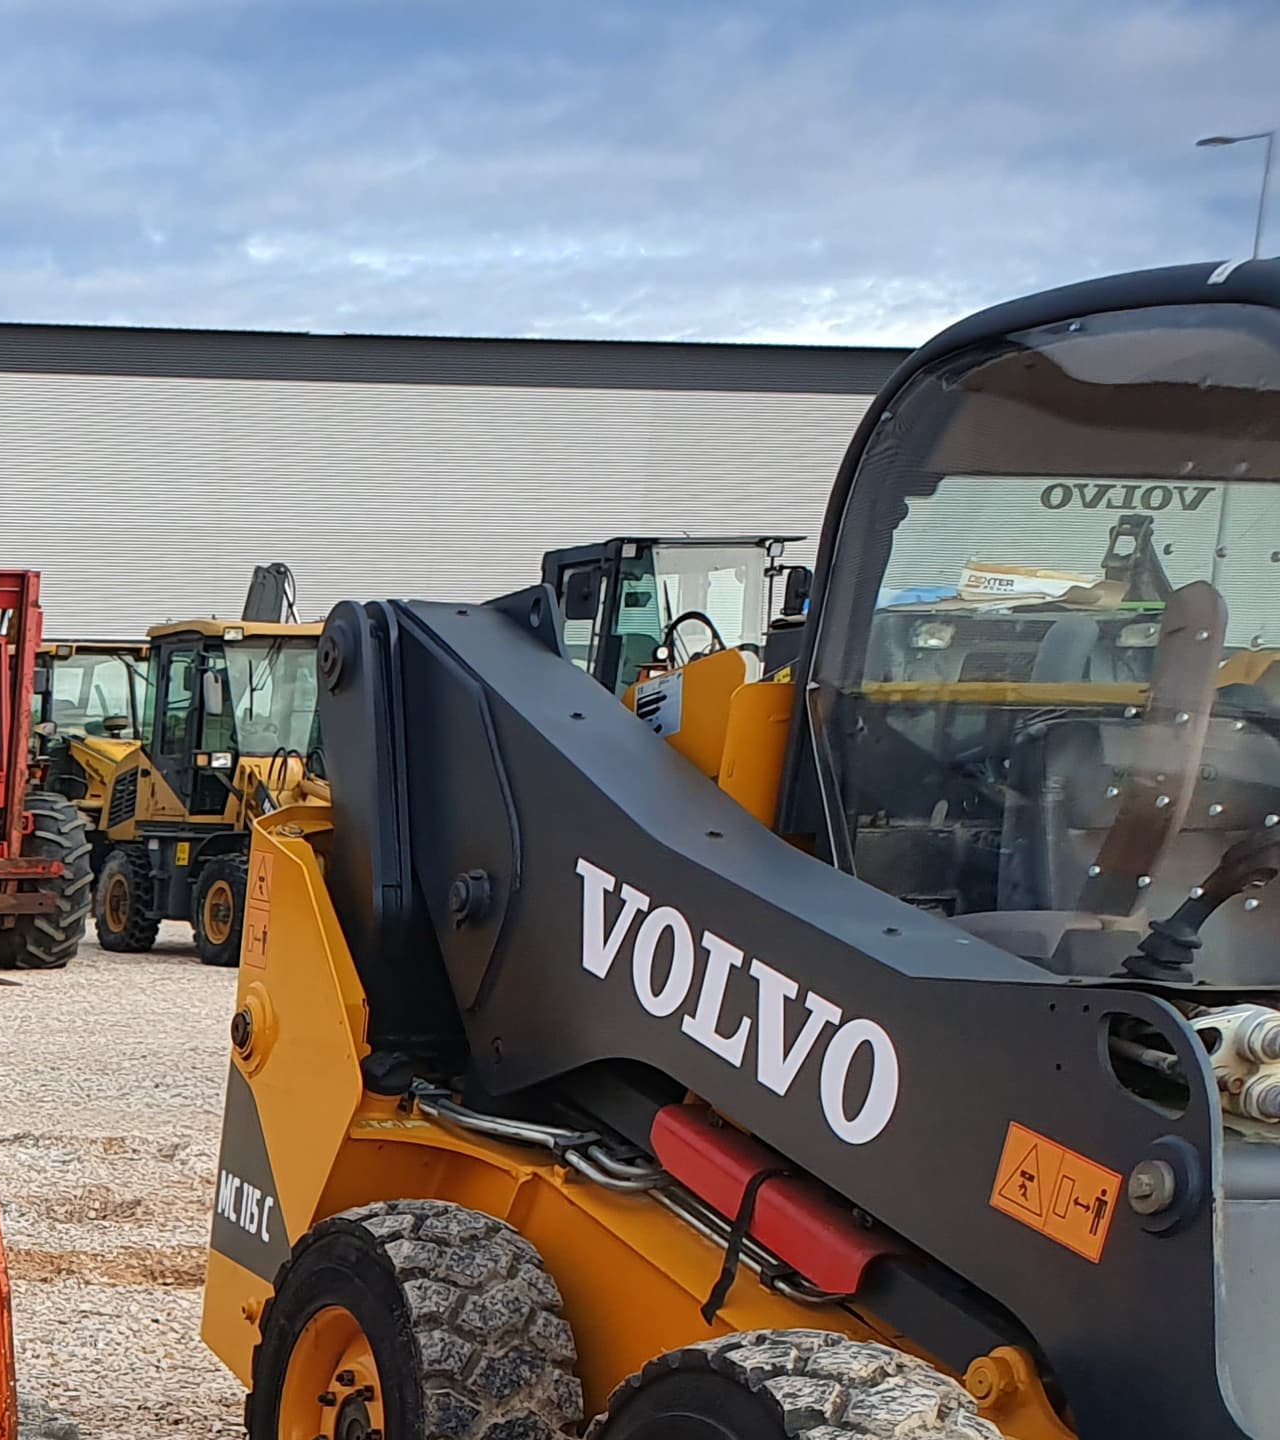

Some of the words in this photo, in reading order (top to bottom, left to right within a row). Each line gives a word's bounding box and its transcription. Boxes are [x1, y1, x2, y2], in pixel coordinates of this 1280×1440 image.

[575, 856, 900, 1145] VOLVO
[217, 1169, 241, 1223] MC
[240, 1182, 262, 1234] 115
[261, 1195, 274, 1243] C
